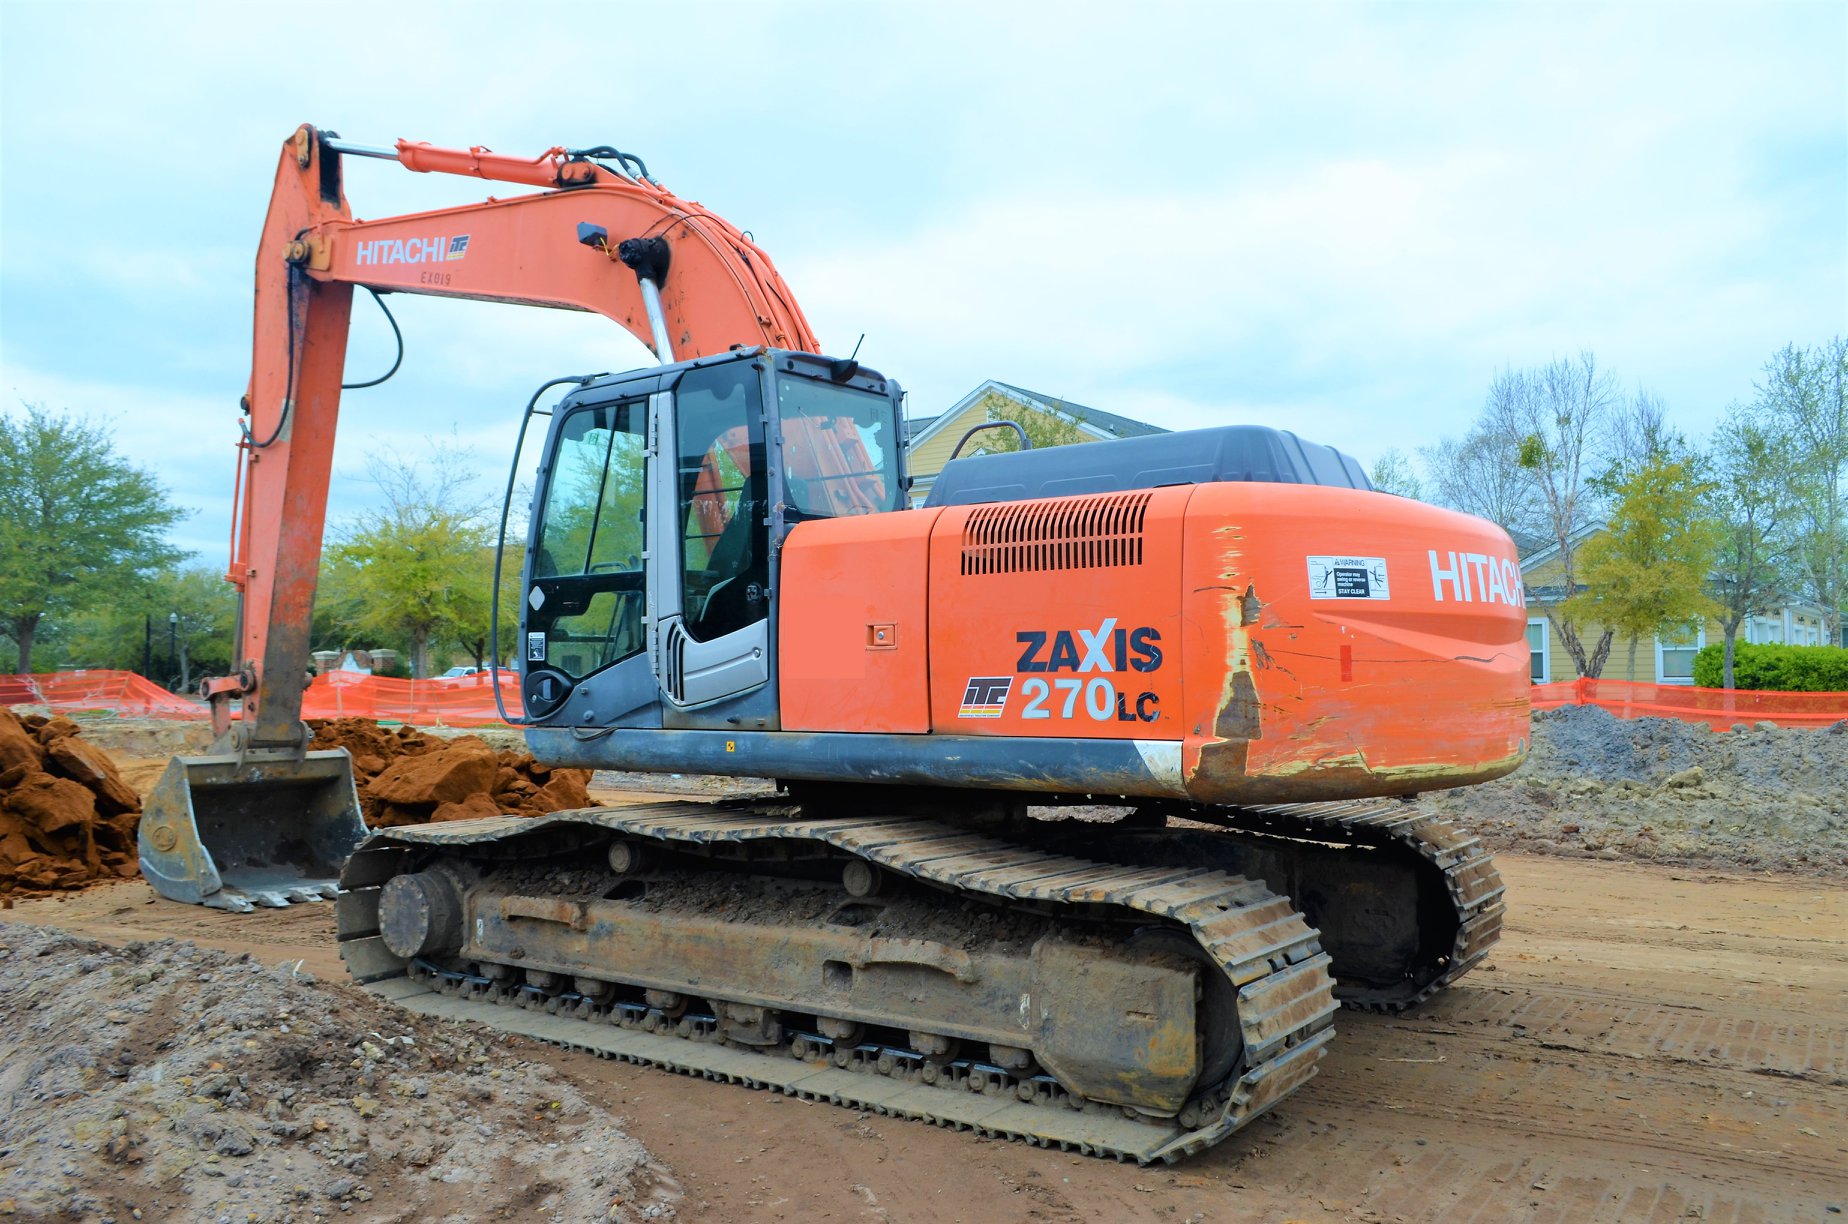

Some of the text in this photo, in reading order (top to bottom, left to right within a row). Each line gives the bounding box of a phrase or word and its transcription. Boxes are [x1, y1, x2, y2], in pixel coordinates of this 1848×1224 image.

[356, 236, 446, 265] HITACHI
[420, 271, 451, 286] EX019
[1016, 618, 1163, 673] ZAXIS
